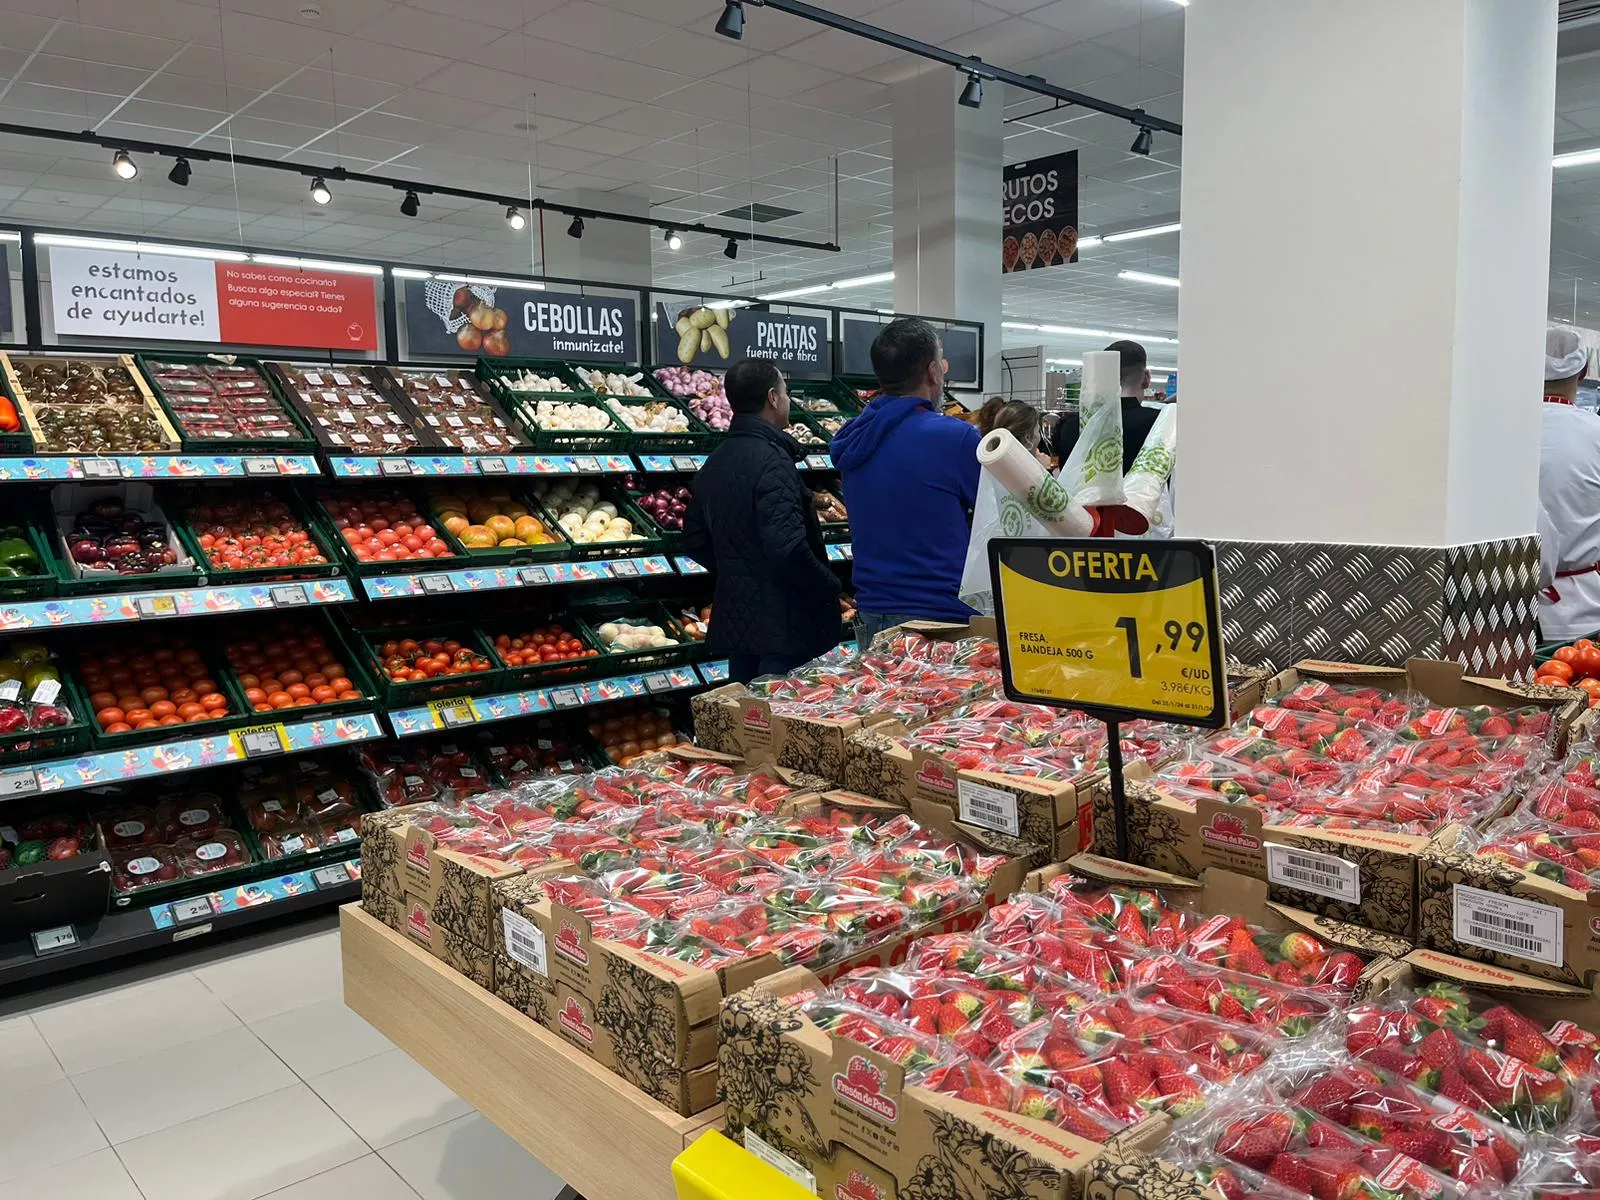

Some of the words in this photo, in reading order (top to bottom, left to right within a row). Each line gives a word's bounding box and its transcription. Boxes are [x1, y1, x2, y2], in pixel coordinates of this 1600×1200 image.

[88, 263, 178, 283] estamos
[226, 270, 240, 278] No
[241, 271, 267, 281] sabes
[268, 274, 293, 283] como
[71, 285, 197, 305] encantados
[227, 284, 257, 294] Buscas
[258, 287, 279, 297] algo
[280, 289, 319, 299] especial?
[320, 291, 345, 301] Tienes
[66, 301, 93, 319] de
[103, 306, 205, 326] ayudarte!
[228, 298, 260, 308] alguna
[261, 301, 308, 311] sugerencia
[308, 304, 315, 312] o
[316, 305, 343, 314] duda?
[523, 301, 623, 337] CEBOLLAS
[552, 336, 625, 354] inmunízate!
[757, 321, 817, 351] PATATAS
[745, 345, 779, 359] fuente
[781, 348, 794, 361] de
[796, 349, 817, 362] fibra
[1047, 550, 1159, 582] OFERTA
[1020, 643, 1064, 657] BANDEJA
[1065, 648, 1083, 659] 500
[1085, 650, 1094, 660] G
[1181, 667, 1210, 680] €/UD
[1420, 952, 1463, 968] Fresón
[1480, 968, 1515, 982] Palos
[836, 1079, 863, 1102] Fresón
[863, 1092, 873, 1106] de
[873, 1097, 894, 1118] Palos
